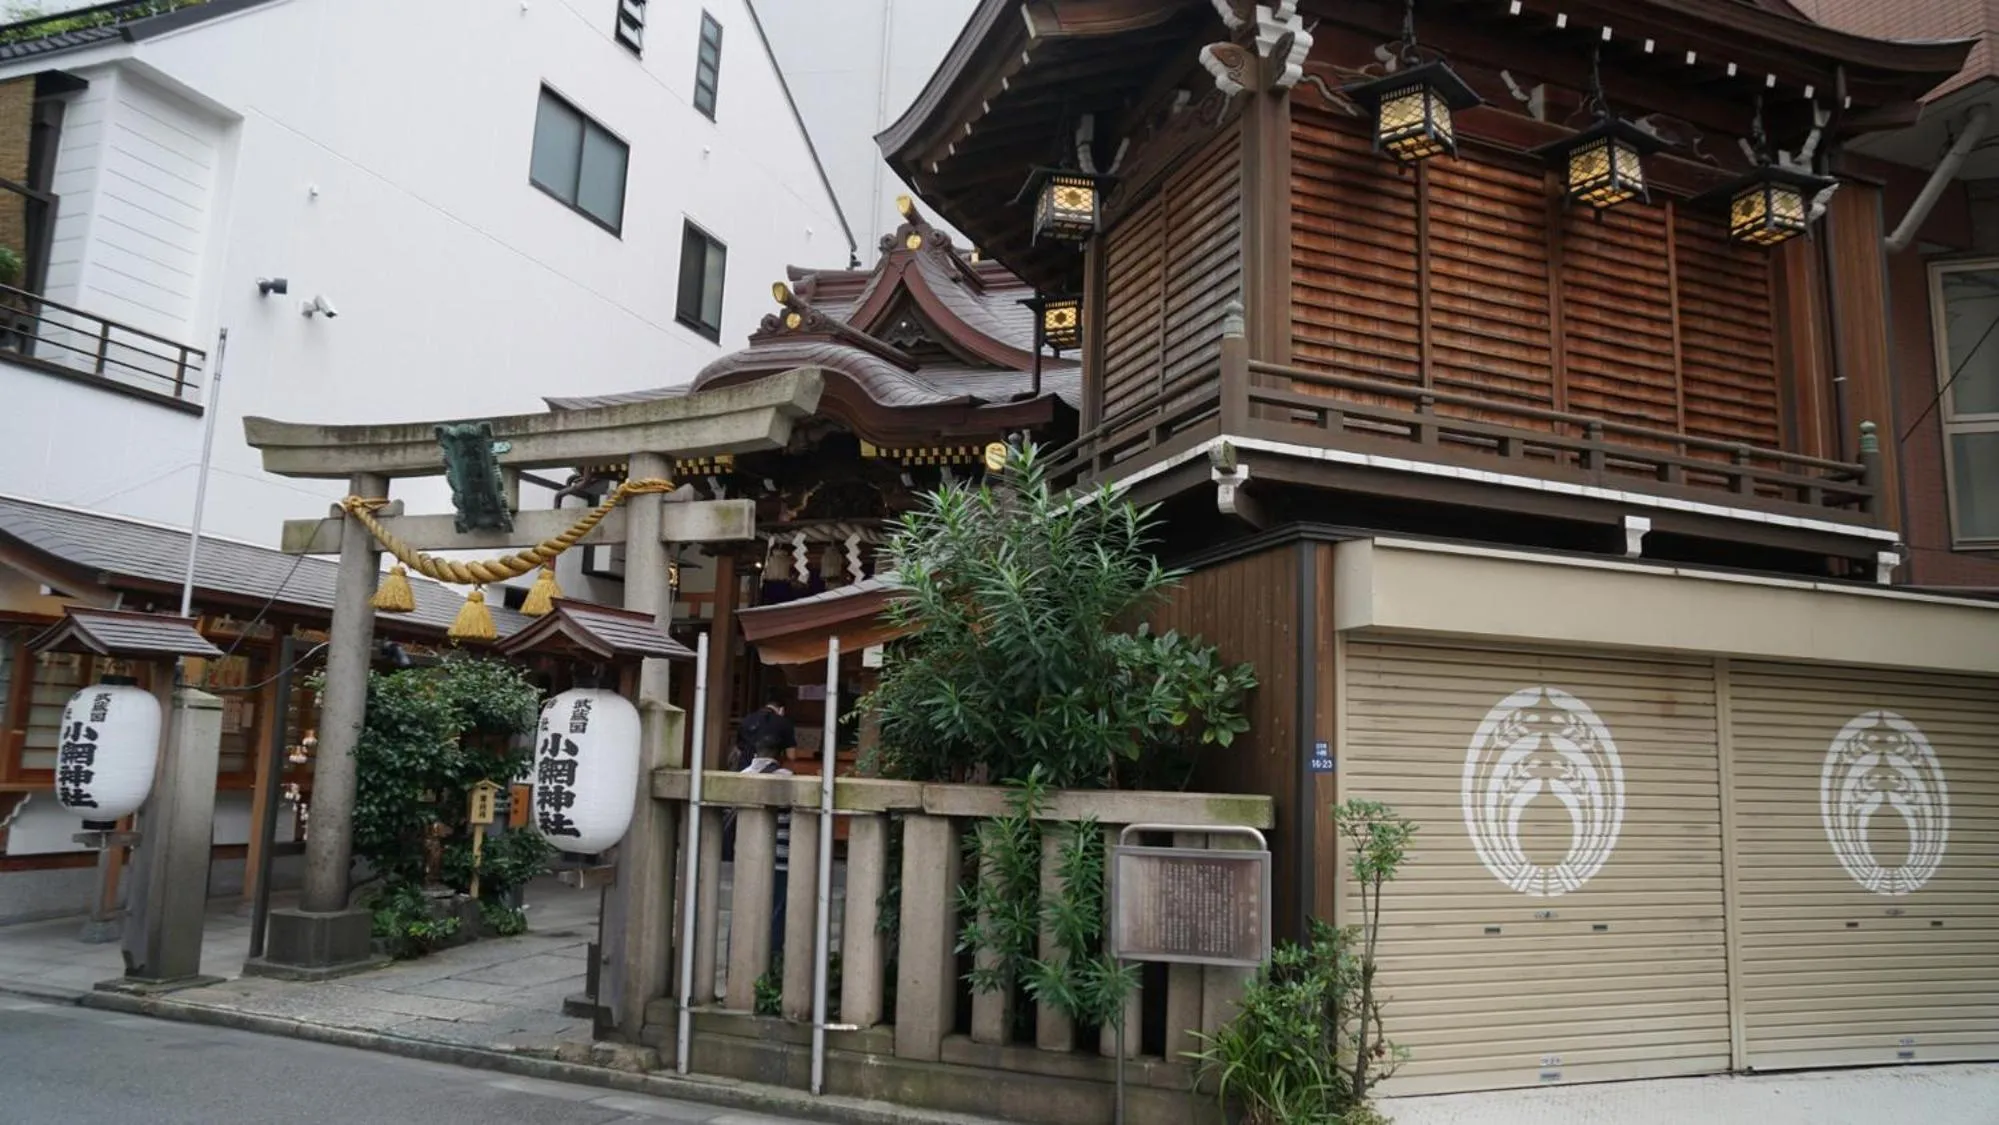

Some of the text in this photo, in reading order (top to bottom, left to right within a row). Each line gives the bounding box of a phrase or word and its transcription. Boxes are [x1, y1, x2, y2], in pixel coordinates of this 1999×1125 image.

[59, 721, 98, 808] 小網神社
[537, 732, 581, 837] 小網神社
